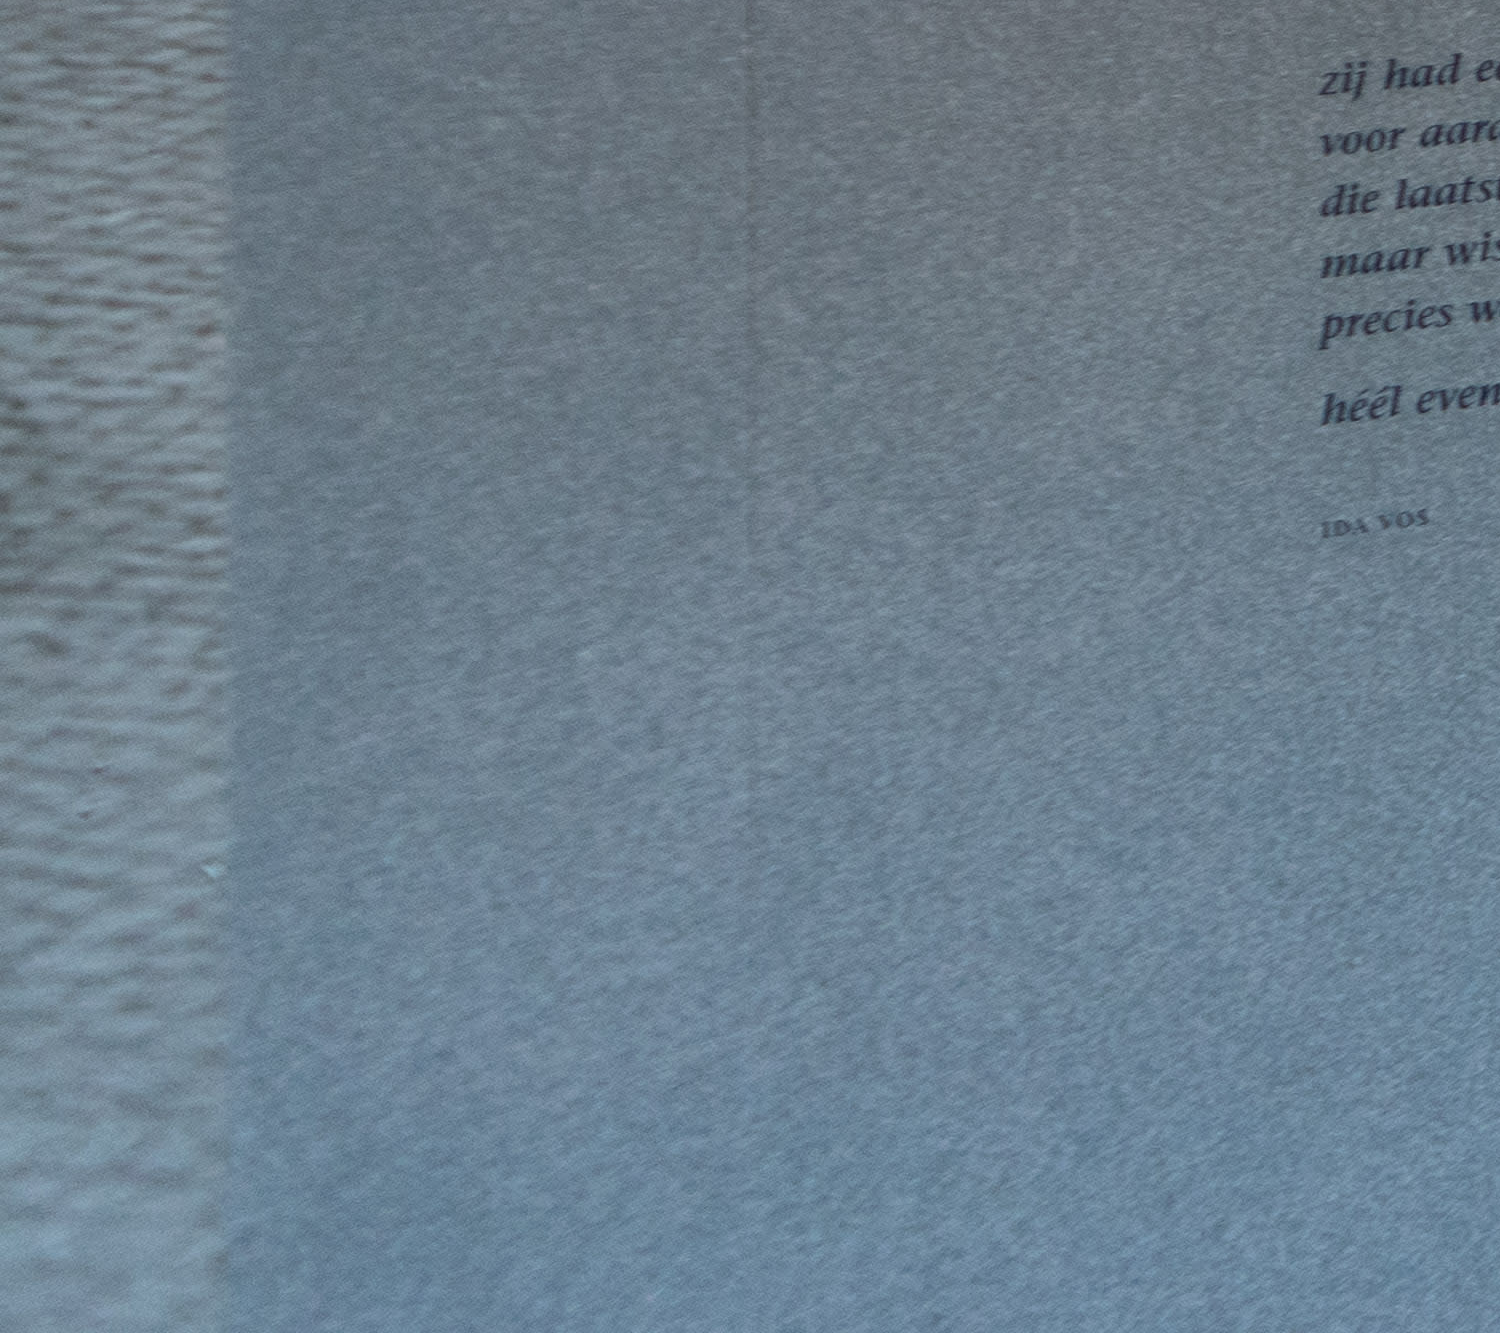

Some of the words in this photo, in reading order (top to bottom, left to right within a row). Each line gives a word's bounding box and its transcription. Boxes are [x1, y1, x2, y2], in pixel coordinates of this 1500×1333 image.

[1318, 60, 1369, 101] zij
[1383, 53, 1462, 91] had
[1320, 126, 1406, 156] voor
[1320, 182, 1380, 217] die
[1320, 246, 1432, 279] maar
[1318, 297, 1454, 351] precies
[1320, 383, 1402, 427] héél
[1320, 514, 1370, 539] IDA
[1377, 506, 1431, 532] VOS
